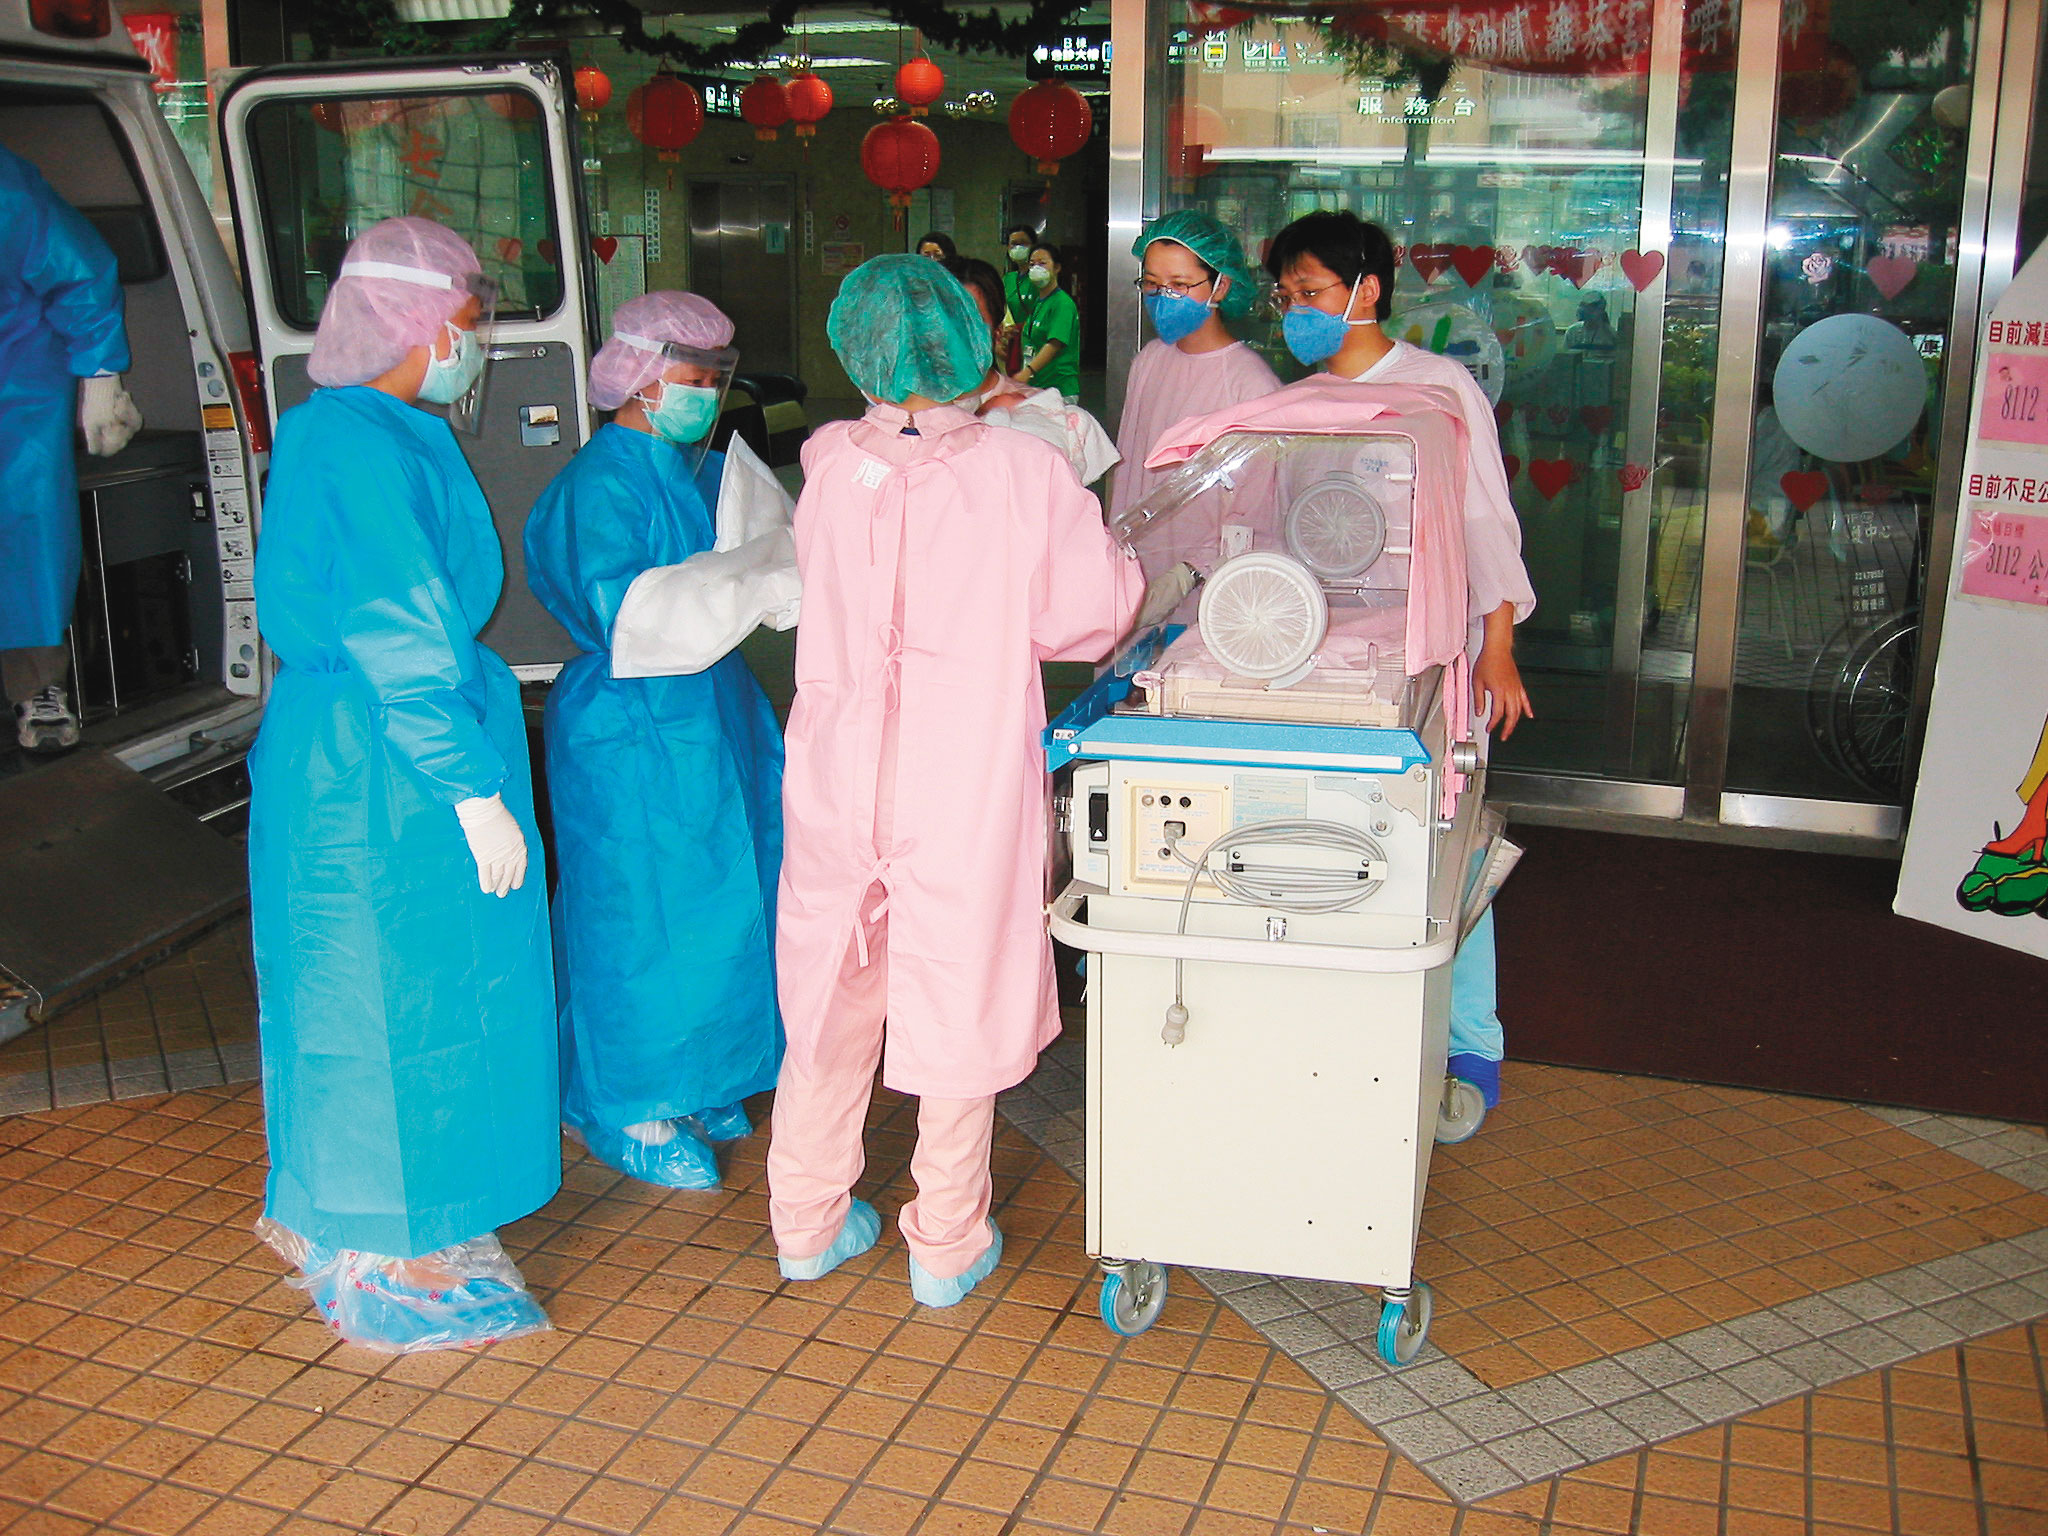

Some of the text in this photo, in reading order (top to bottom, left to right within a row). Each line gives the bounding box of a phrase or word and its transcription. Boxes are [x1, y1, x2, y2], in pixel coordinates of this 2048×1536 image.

[1358, 96, 1476, 117] 服務台
[1378, 116, 1456, 124] Information
[2001, 384, 2039, 421] 8112
[1985, 542, 2021, 576] 3112
